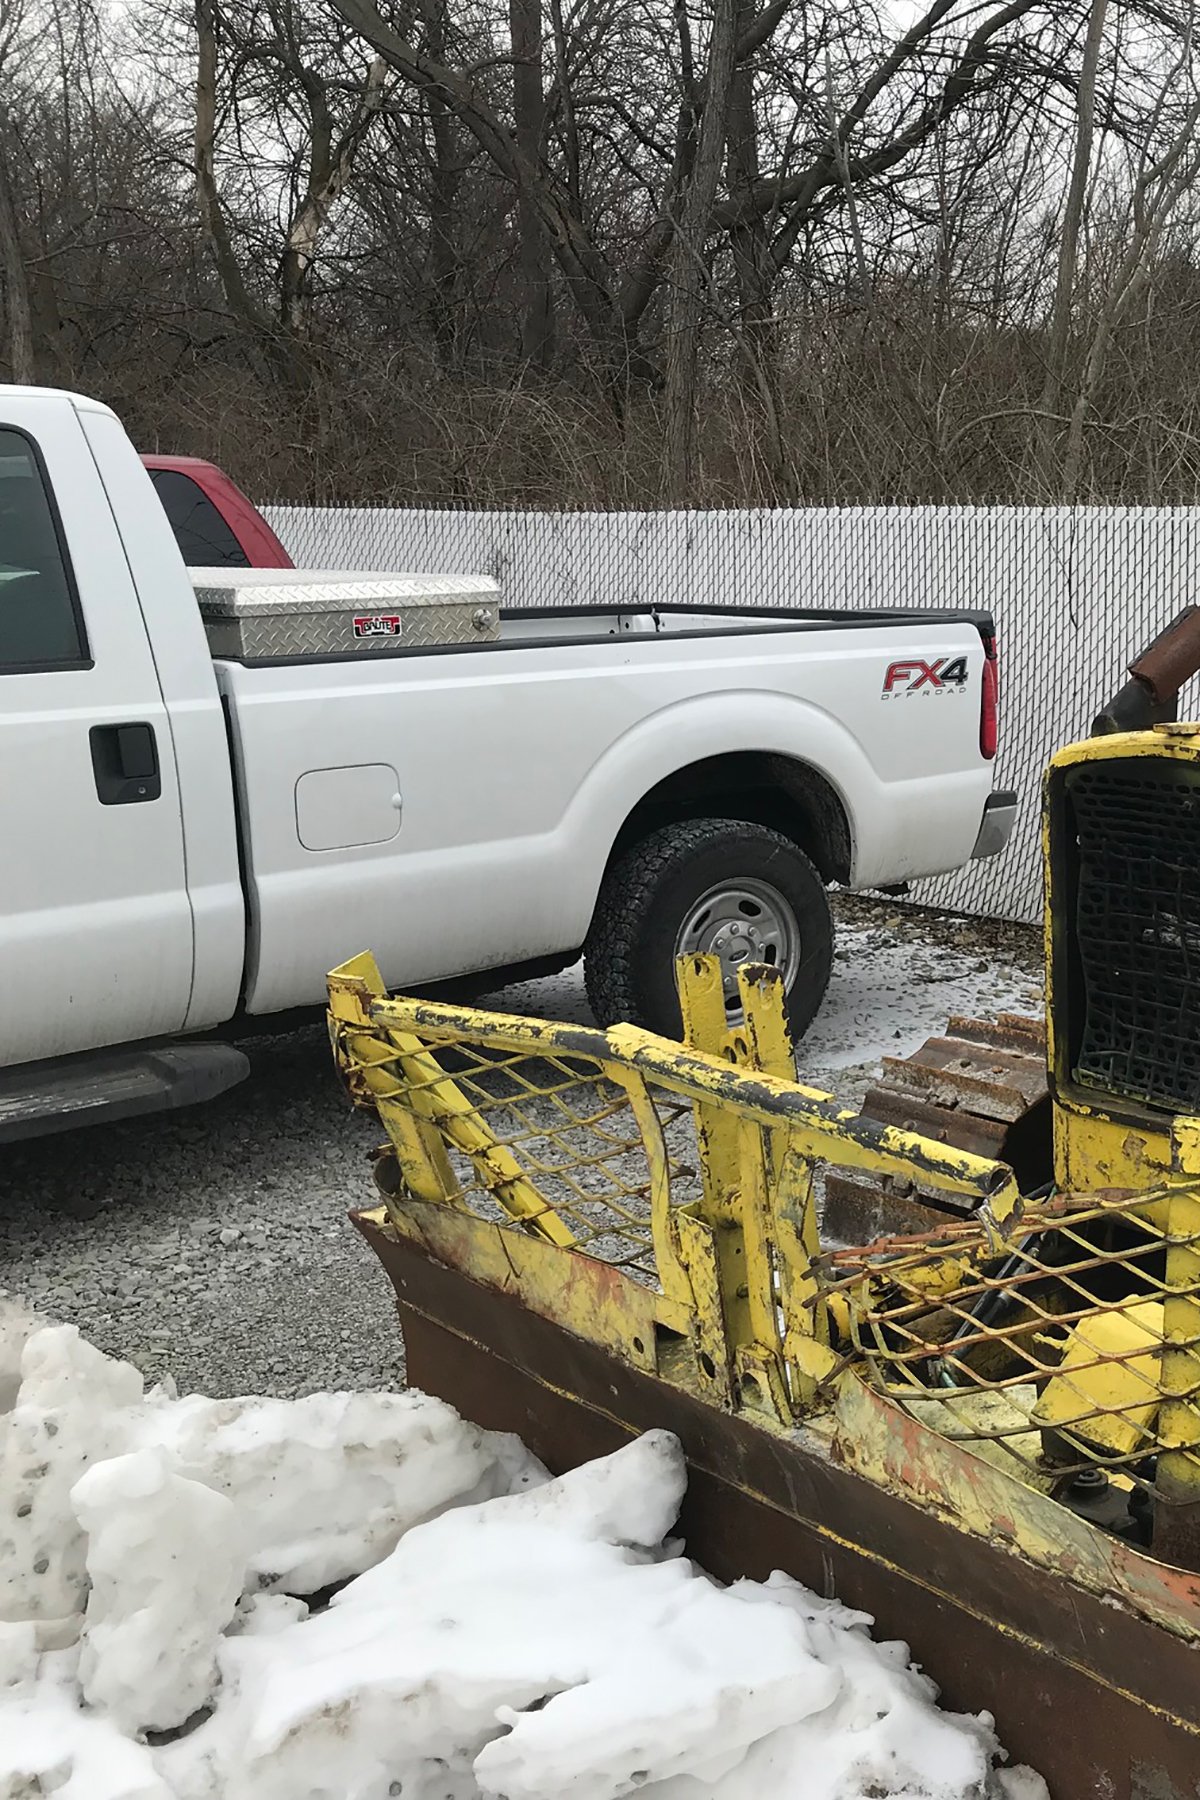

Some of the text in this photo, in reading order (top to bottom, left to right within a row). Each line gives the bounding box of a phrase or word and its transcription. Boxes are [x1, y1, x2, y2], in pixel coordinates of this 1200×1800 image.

[363, 621, 391, 631] BRUTE
[882, 656, 968, 692] FX4
[881, 687, 967, 700] OFF ROAD
